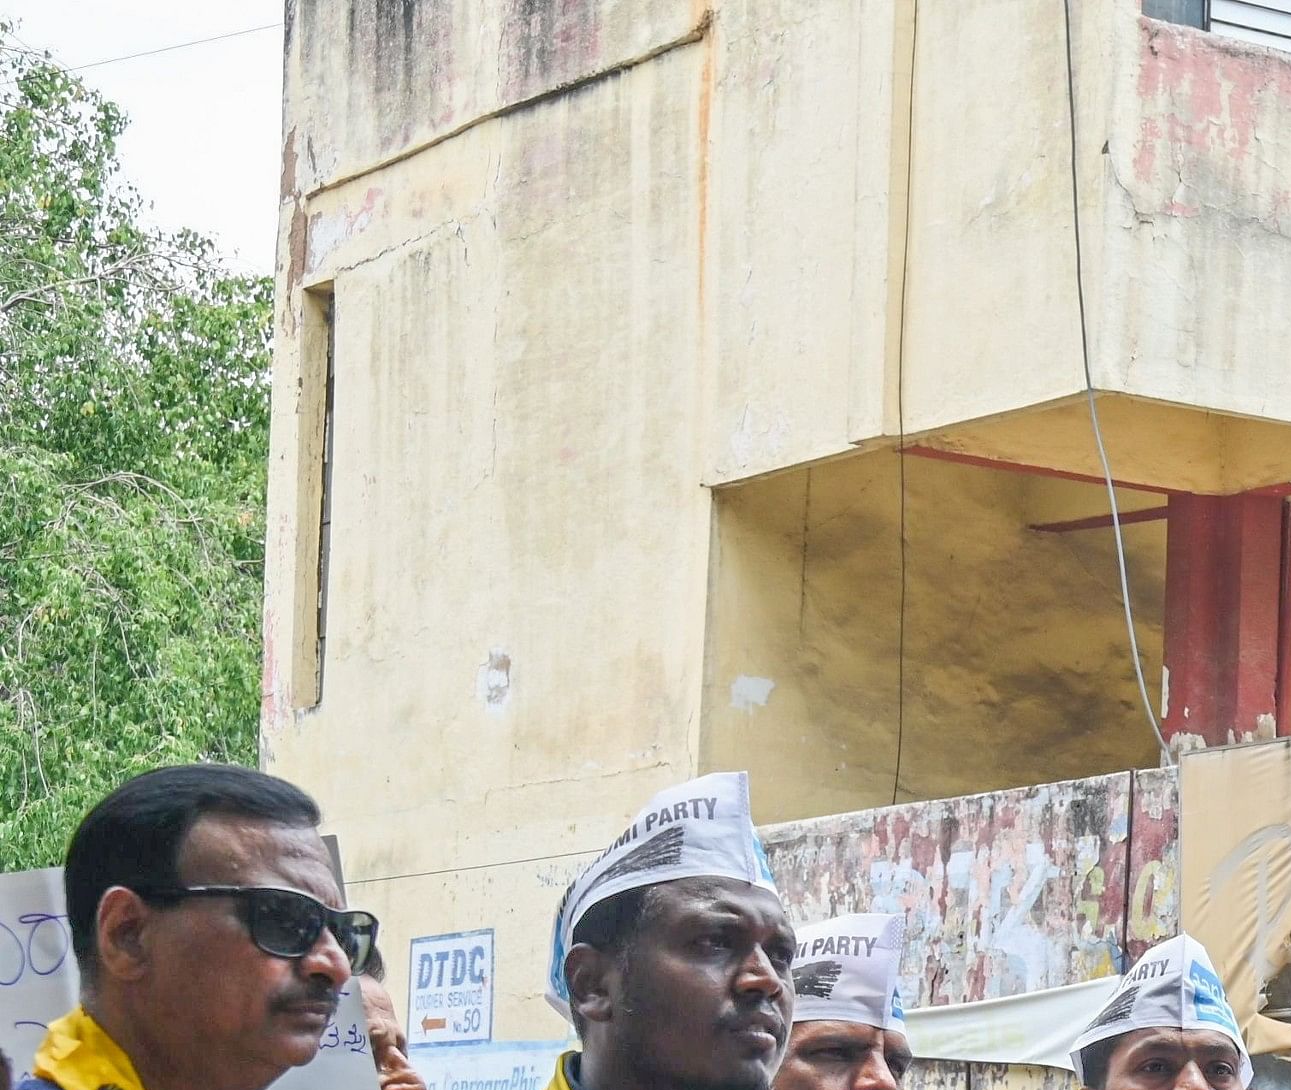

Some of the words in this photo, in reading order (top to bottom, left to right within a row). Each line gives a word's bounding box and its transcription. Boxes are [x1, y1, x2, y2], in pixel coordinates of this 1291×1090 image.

[645, 797, 718, 832] PARTY
[811, 936, 878, 958] PARTY
[416, 945, 486, 989] DTDC
[1124, 958, 1170, 988] PARTY
